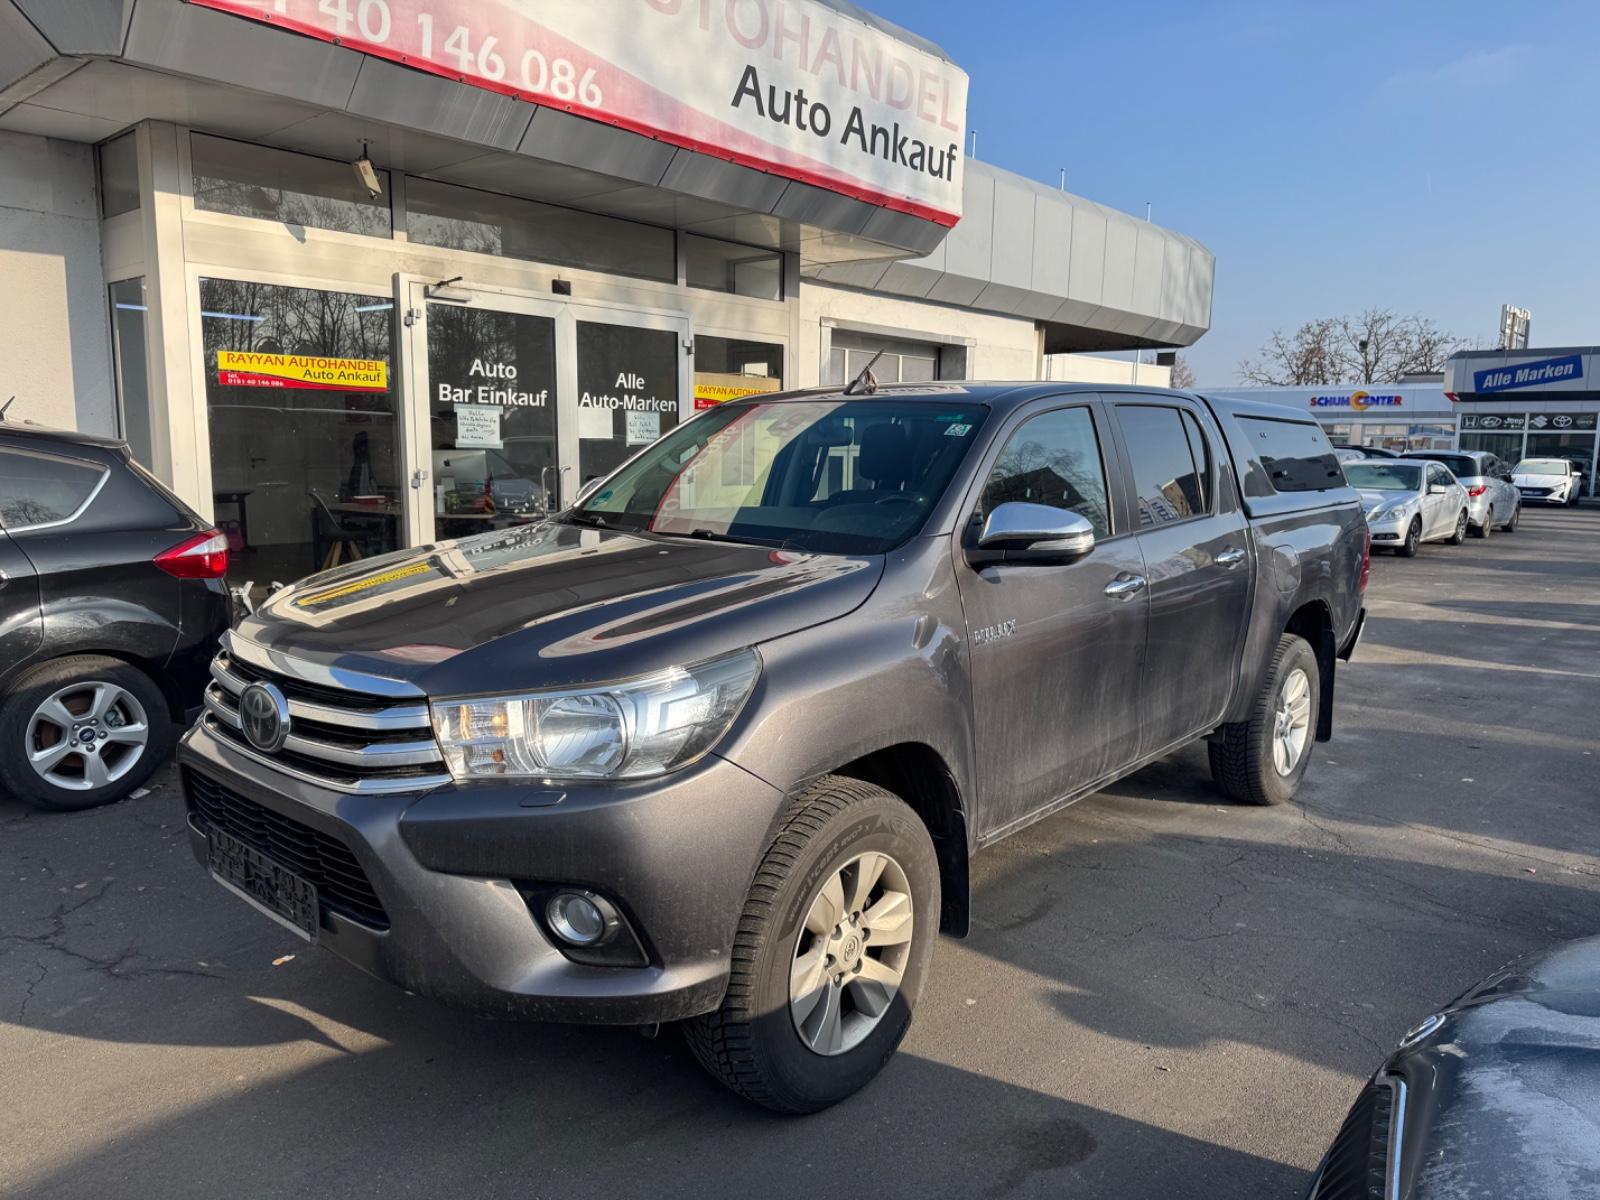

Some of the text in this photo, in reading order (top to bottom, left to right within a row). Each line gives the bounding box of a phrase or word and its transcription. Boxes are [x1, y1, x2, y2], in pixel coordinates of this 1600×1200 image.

[417, 13, 505, 82] 146
[521, 49, 603, 107] 086
[731, 64, 957, 182] Auto Ankauf
[226, 352, 381, 372] RAYYAN AUTOHANDEL
[469, 359, 518, 380] Auto
[303, 368, 381, 383] Auto Ankauf
[615, 372, 645, 390] Alle
[1482, 363, 1574, 389] Alle Marken
[438, 384, 548, 407] Bar Einkauf
[697, 386, 727, 396] RAYYAN
[579, 391, 677, 413] Auto-Marken
